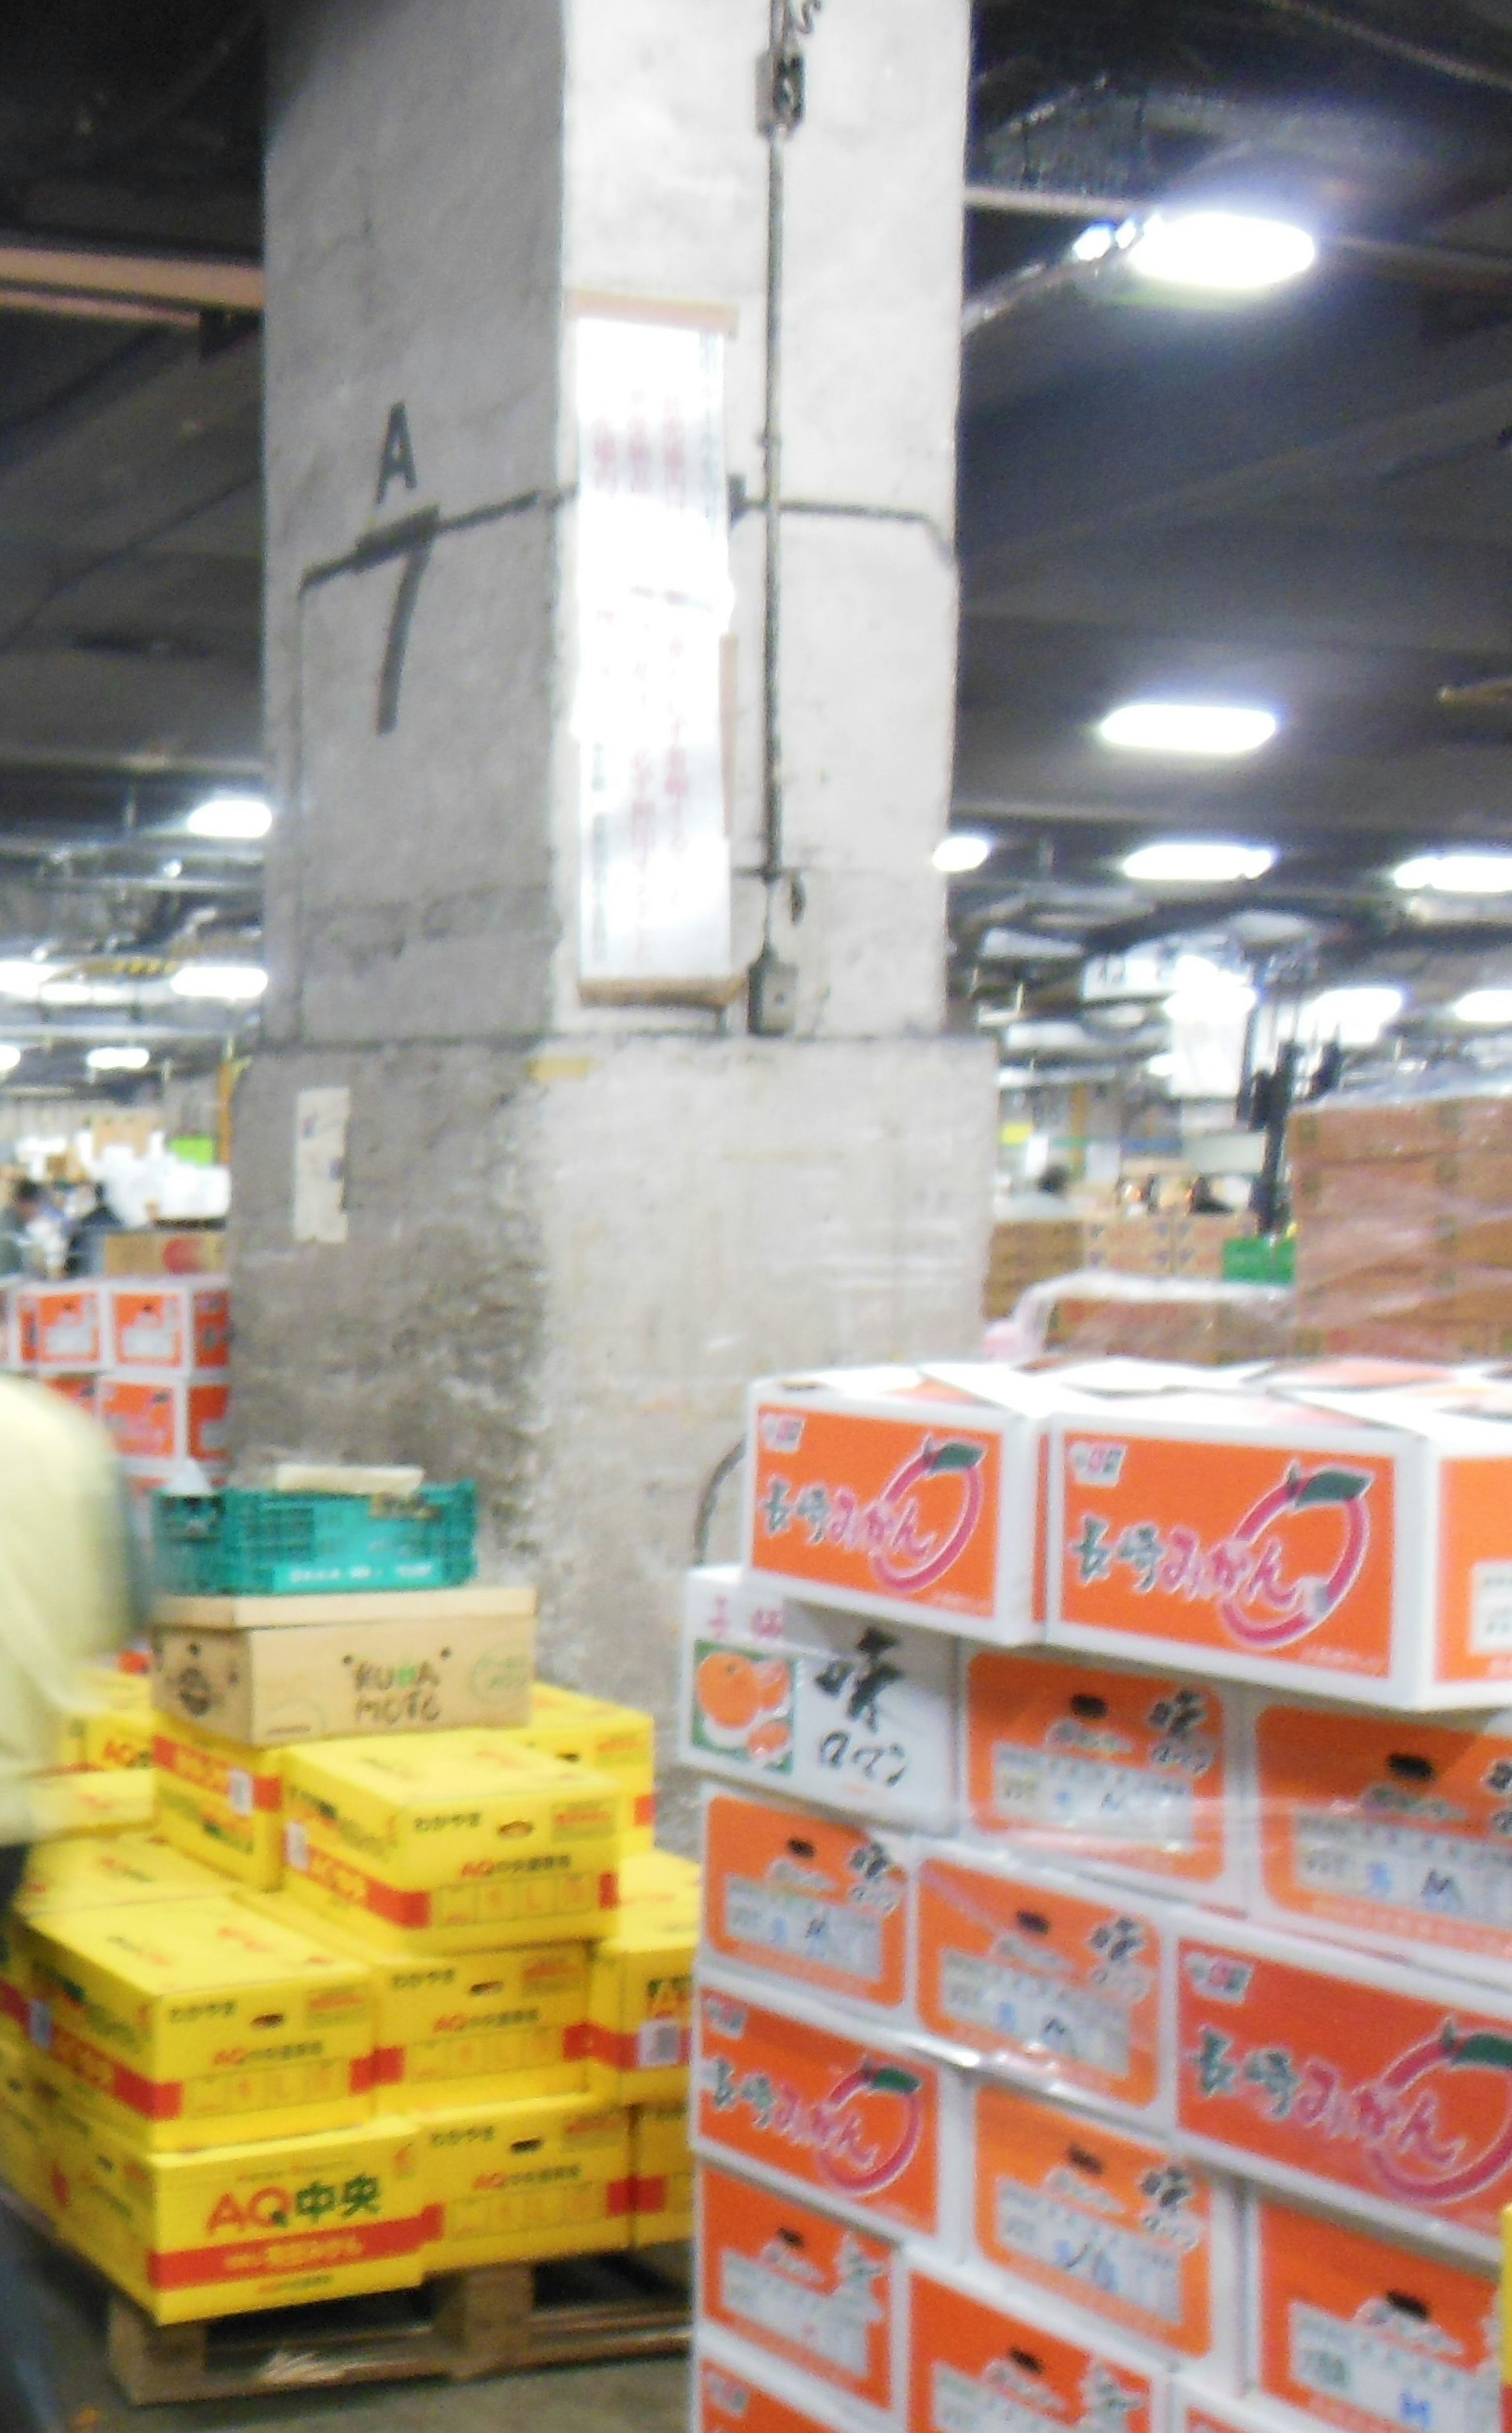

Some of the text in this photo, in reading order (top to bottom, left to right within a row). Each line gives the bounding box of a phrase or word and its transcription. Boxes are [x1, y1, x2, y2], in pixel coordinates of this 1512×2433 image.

[1071, 1515, 1303, 1611] 長崎みかん
[204, 2174, 385, 2236] AQ中央
